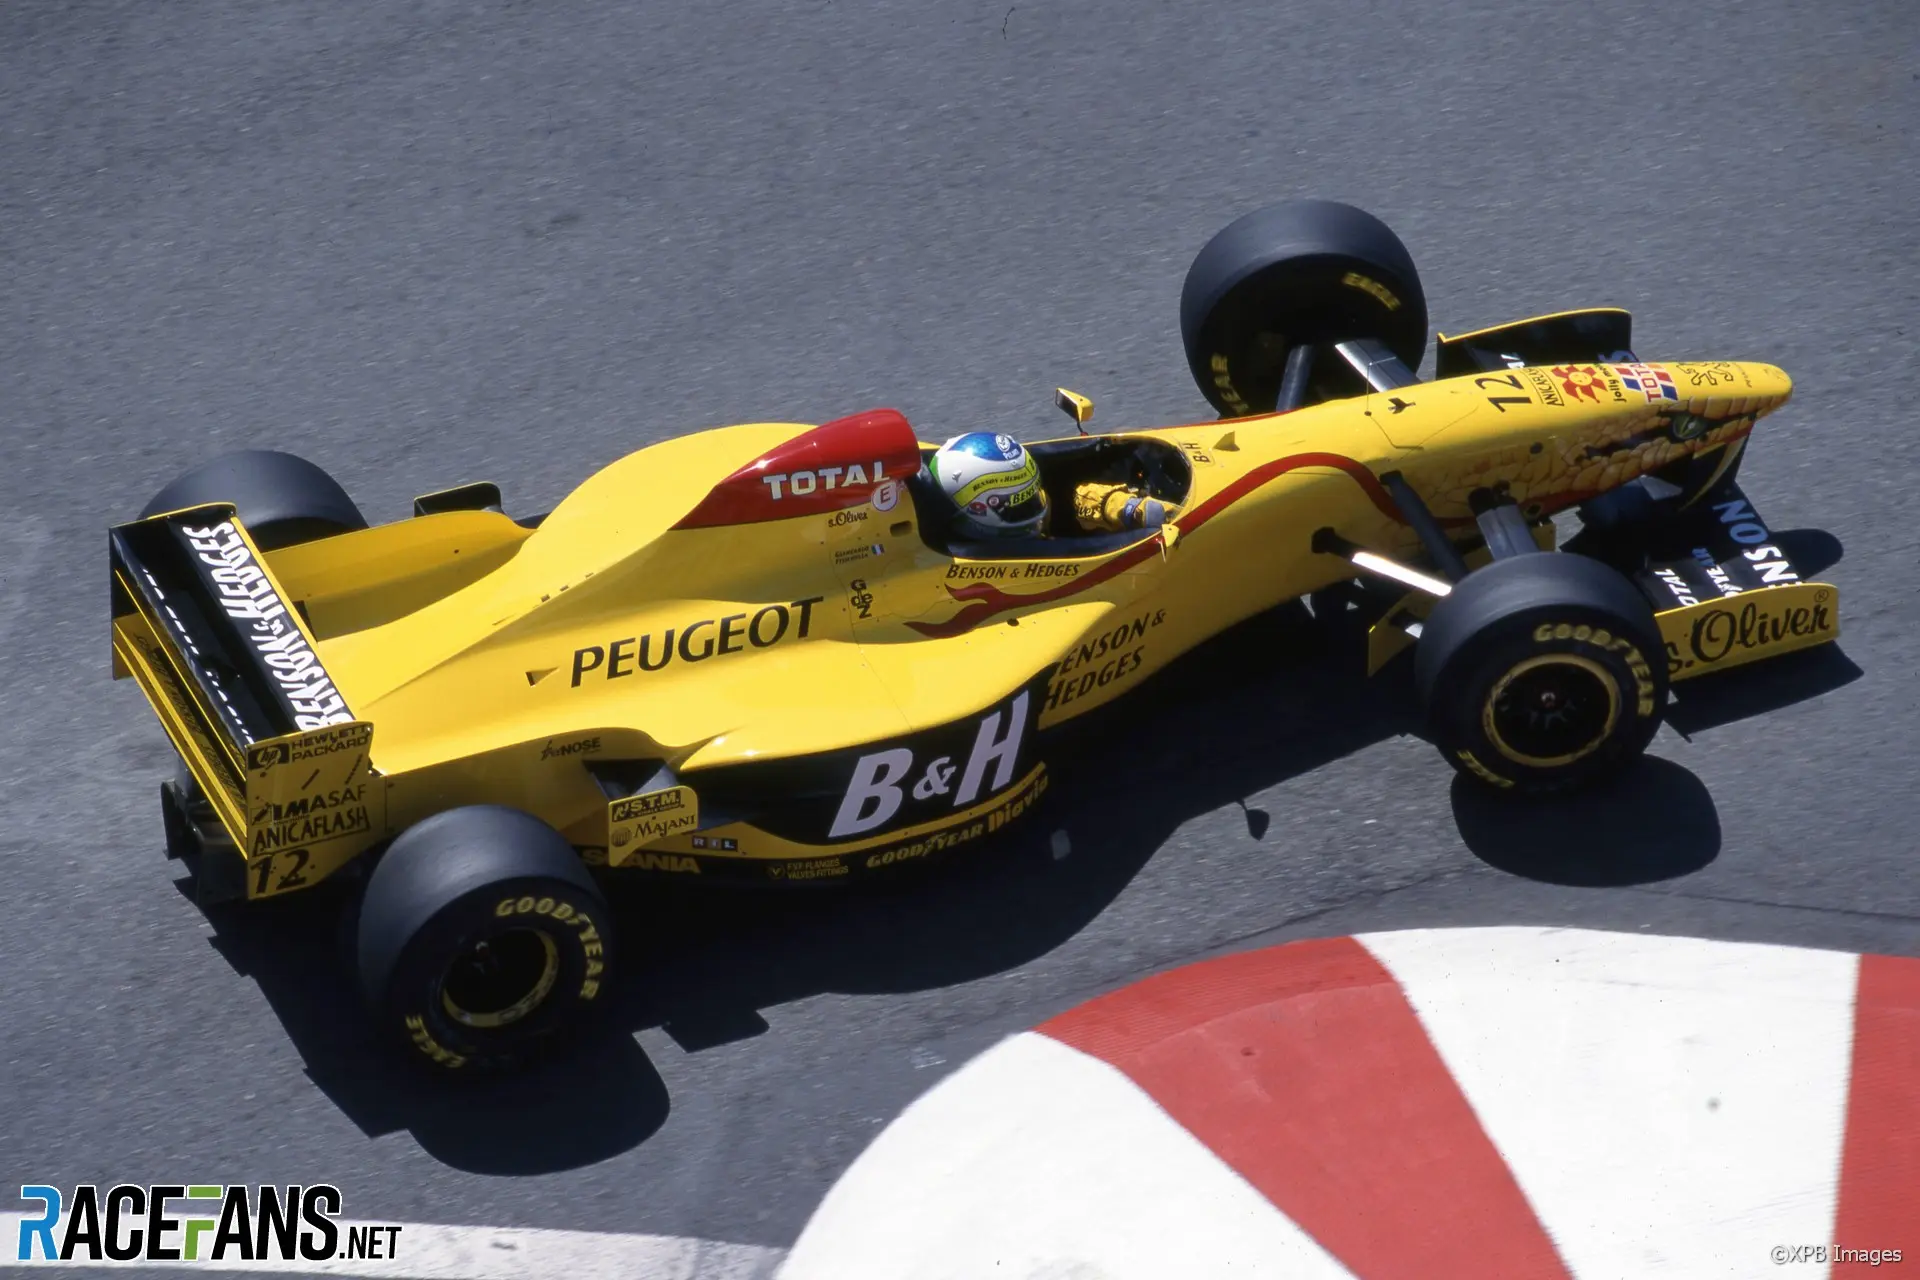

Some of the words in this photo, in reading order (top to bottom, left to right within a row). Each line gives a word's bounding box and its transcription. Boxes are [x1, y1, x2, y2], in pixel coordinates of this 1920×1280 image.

[1474, 374, 1533, 413] 12
[1630, 362, 1663, 403] TOTA
[763, 461, 891, 501] TOTAL
[880, 486, 892, 504] E
[945, 564, 1007, 580] BENSON
[1010, 567, 1020, 578] &
[1023, 563, 1081, 578] HEDGES
[1151, 608, 1167, 628] &
[570, 595, 824, 689] PEUGEOT
[1533, 623, 1655, 717] GOODYEAR
[292, 725, 368, 748] HEWLETT
[292, 734, 370, 762] PACKARD
[252, 806, 371, 857] ANICAFLASH
[866, 822, 984, 868] GOODYEAR
[251, 849, 311, 895] 12
[496, 897, 604, 1000] GOODYEAR
